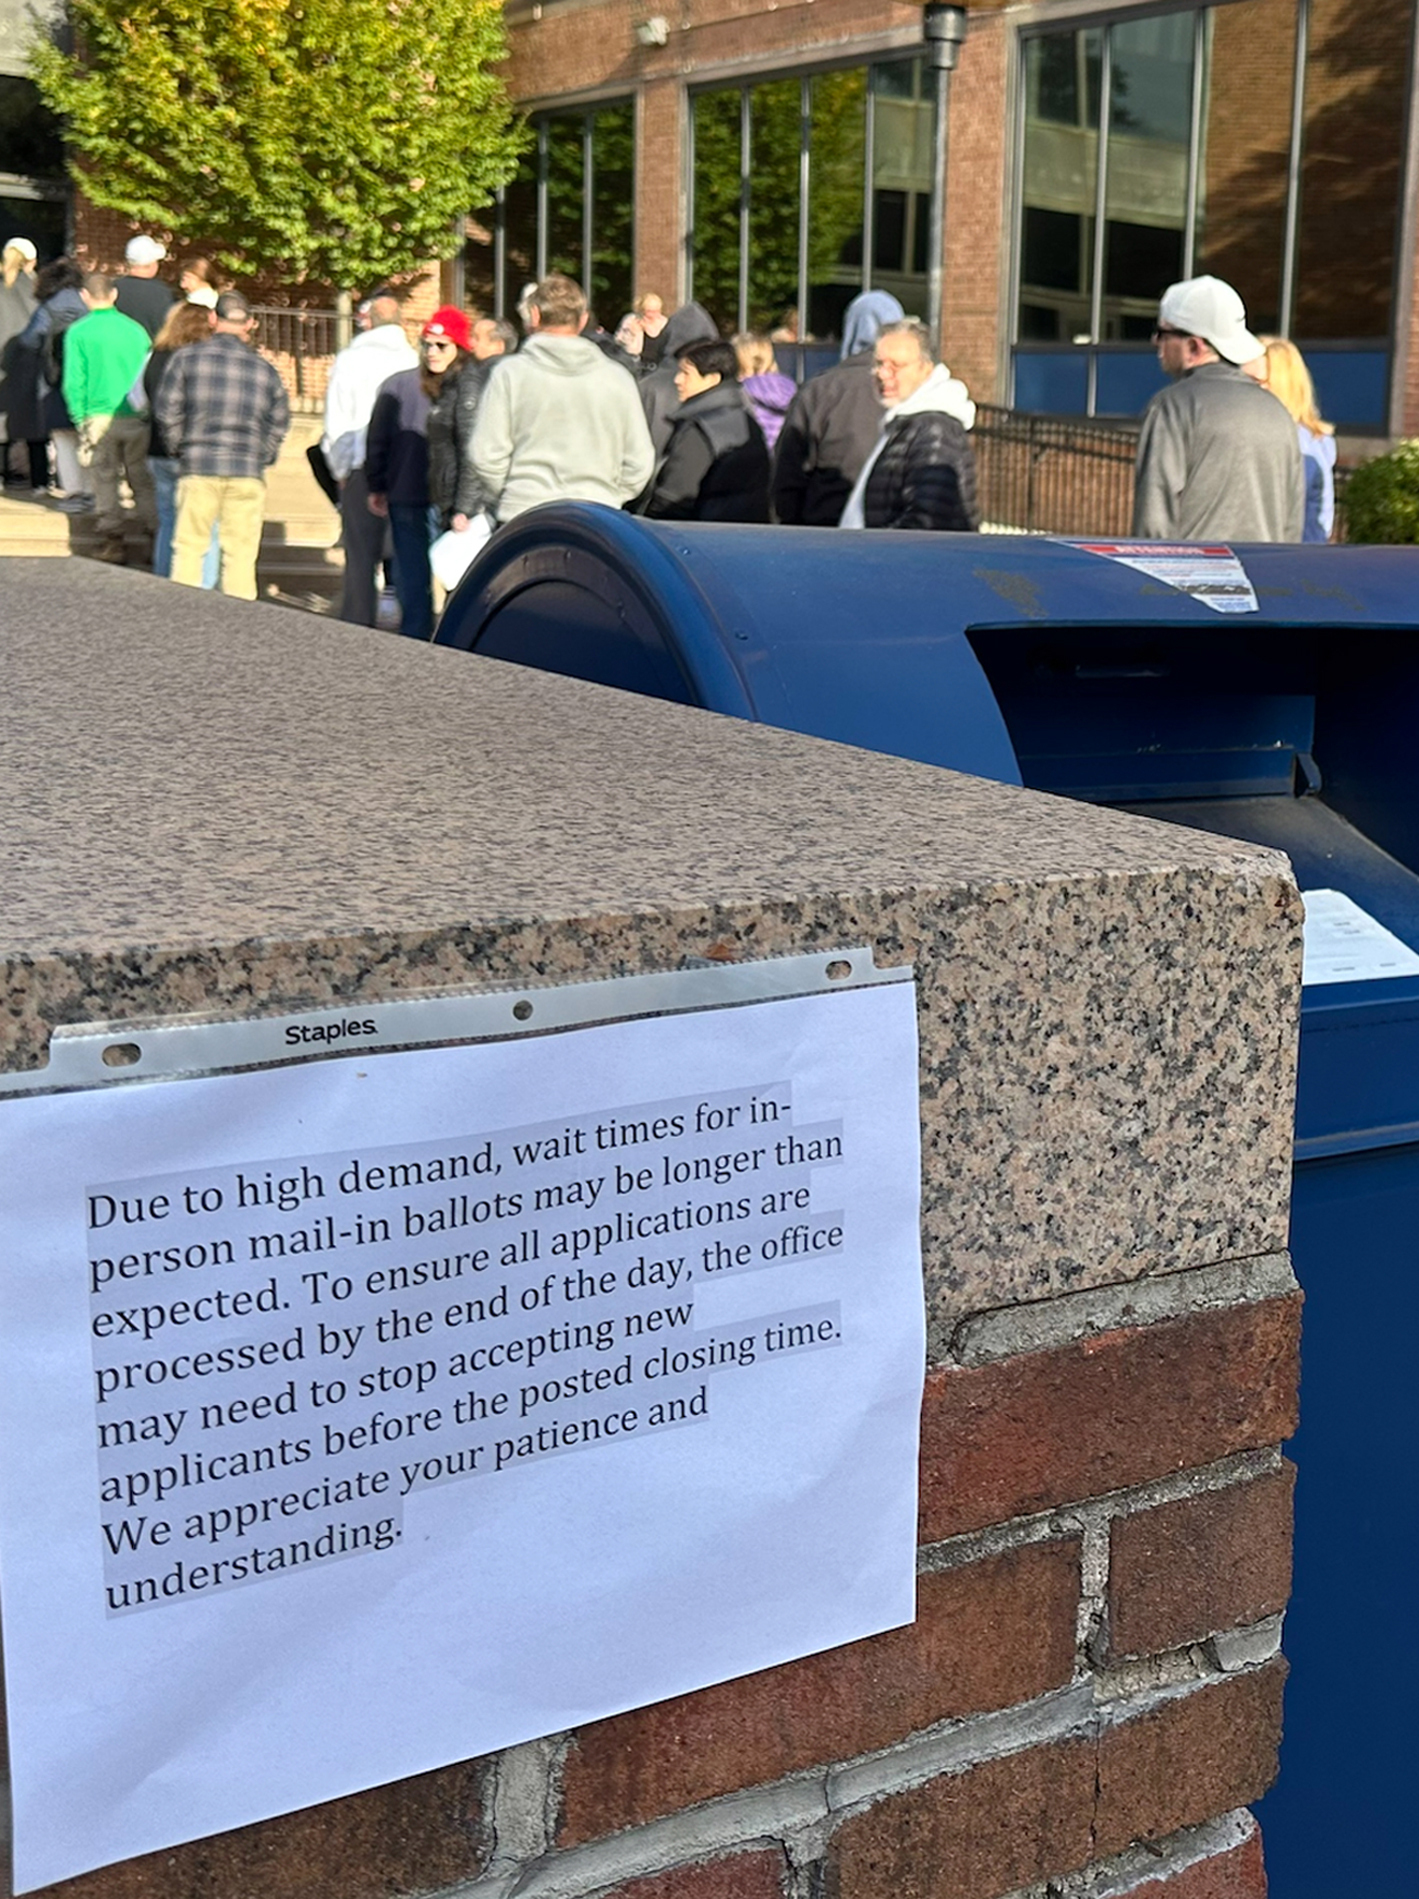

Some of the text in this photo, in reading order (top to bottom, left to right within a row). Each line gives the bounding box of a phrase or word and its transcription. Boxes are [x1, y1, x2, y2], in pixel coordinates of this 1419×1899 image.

[285, 1018, 378, 1045] Staples
[87, 1096, 792, 1230] Due to high demand, wait times for in-
[89, 1135, 843, 1294] person mail-in ballots may be longer than
[91, 1187, 810, 1341] expected. To ensure all applications are
[94, 1224, 844, 1404] processed by the end of the day, the office
[97, 1303, 694, 1449] may need to stop accepting new
[100, 1319, 842, 1508] applicants before the posted closing time.
[100, 1384, 709, 1555] We appreciate your patience and
[105, 1517, 402, 1610] understanding.
